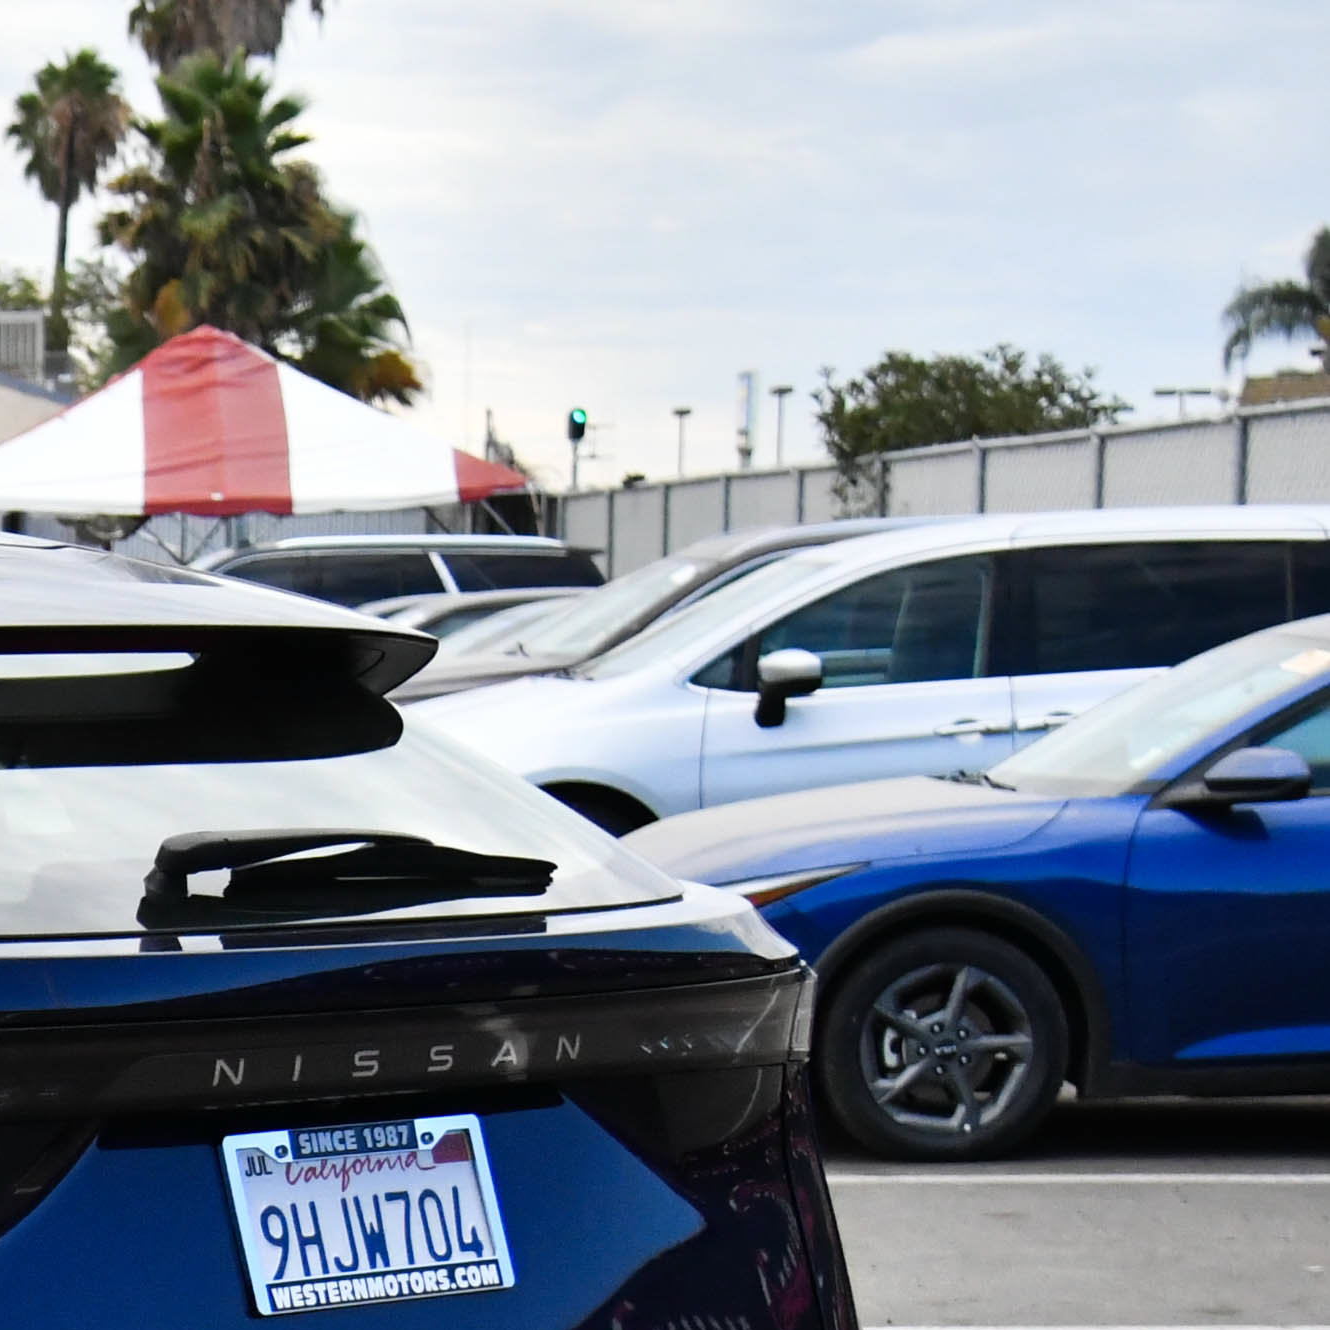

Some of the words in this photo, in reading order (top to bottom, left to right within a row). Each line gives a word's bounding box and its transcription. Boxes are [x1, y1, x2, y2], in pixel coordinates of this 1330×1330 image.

[212, 1033, 582, 1087] NISSAN
[297, 1128, 358, 1156] SINCE
[363, 1124, 409, 1149] 1987
[245, 1156, 273, 1178] JUL
[285, 1150, 436, 1193] California
[260, 1185, 484, 1282] 9HJW704
[271, 1263, 500, 1311] WESTERNMOTORS.COM
